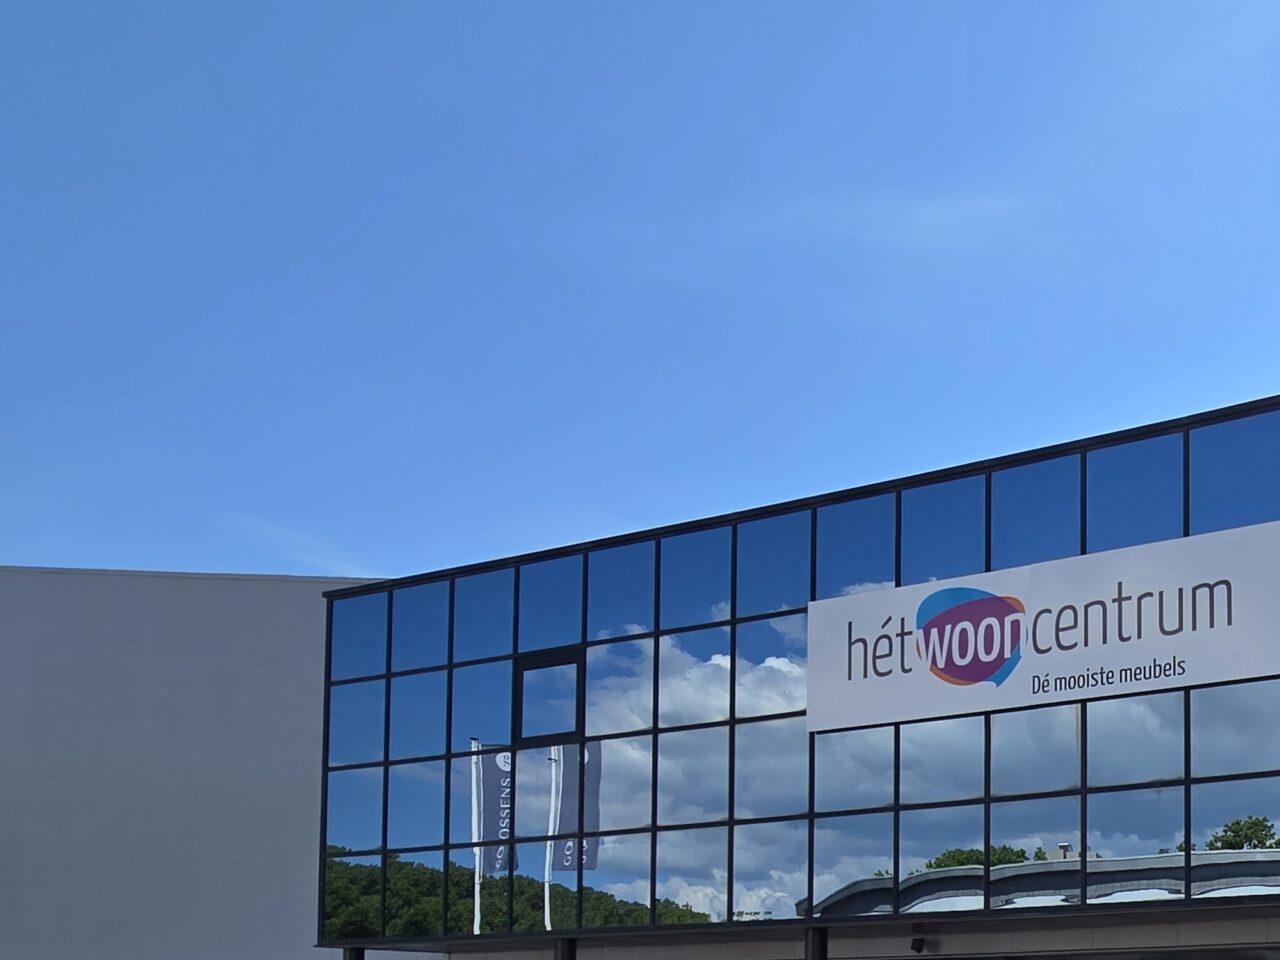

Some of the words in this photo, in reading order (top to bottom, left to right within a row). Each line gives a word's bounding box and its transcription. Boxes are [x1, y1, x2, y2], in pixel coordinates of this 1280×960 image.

[1032, 673, 1050, 695] Dé
[1054, 667, 1115, 692] mooiste
[1119, 655, 1186, 683] meubels
